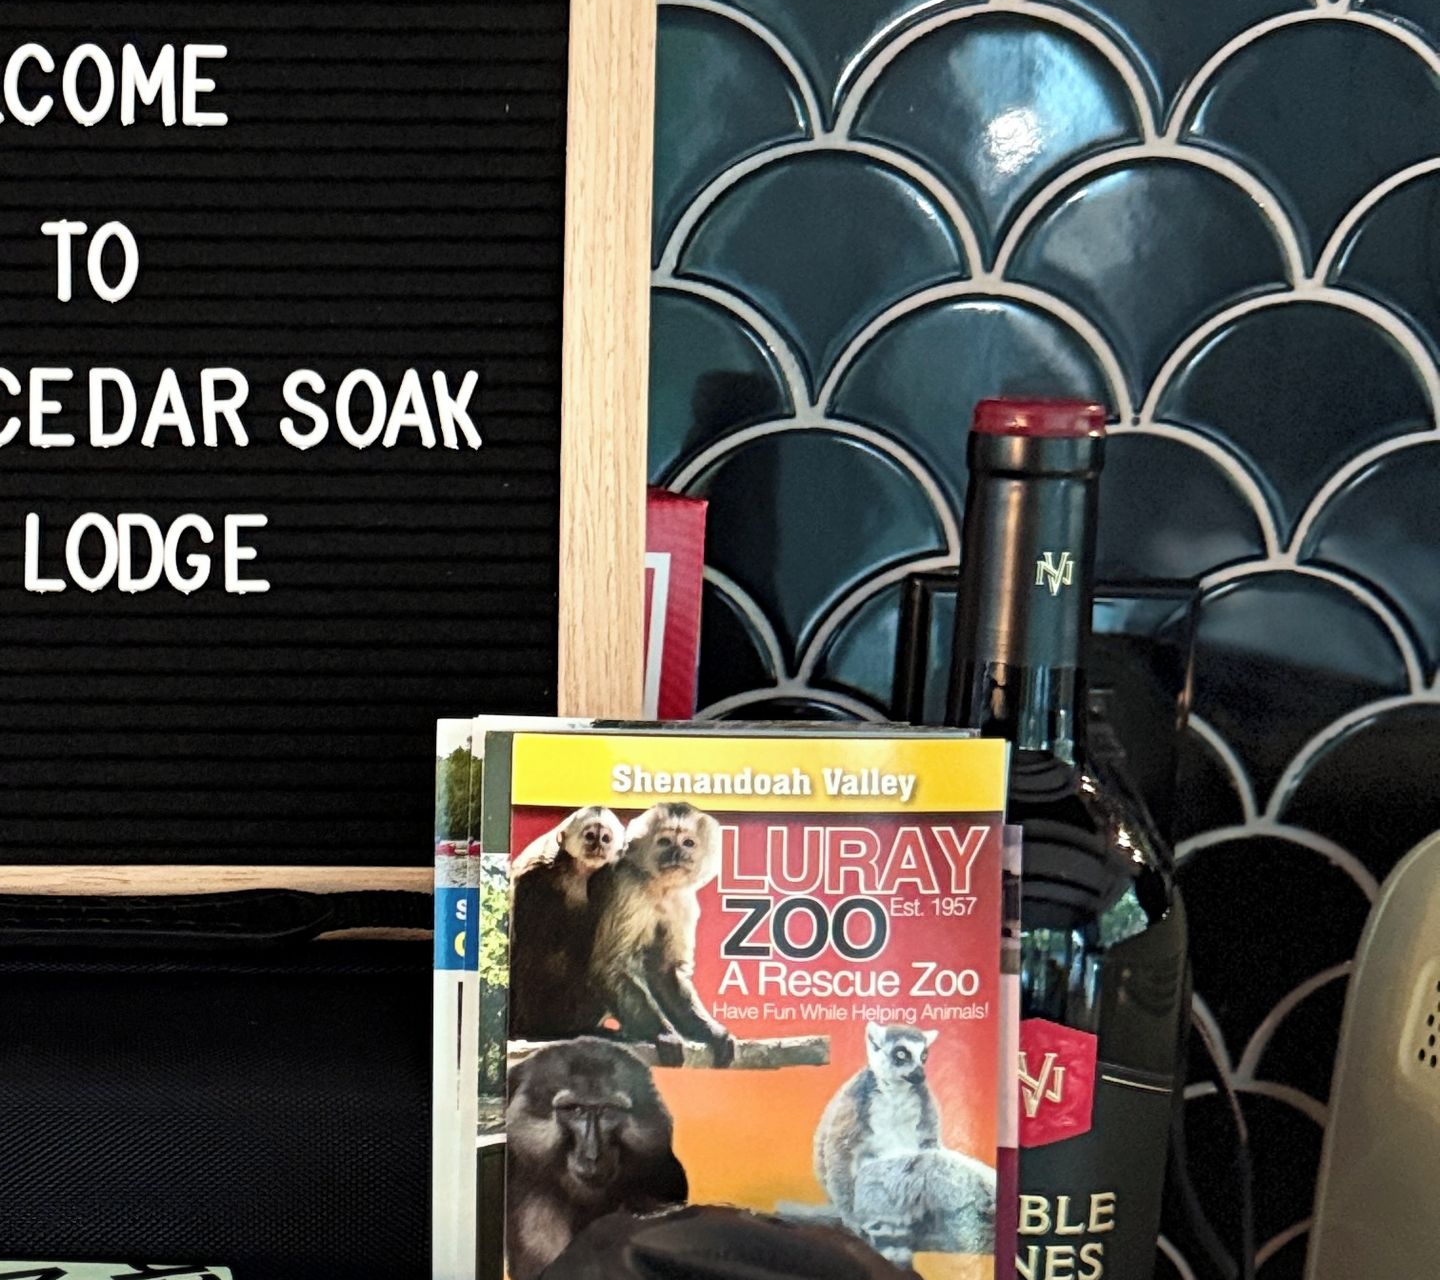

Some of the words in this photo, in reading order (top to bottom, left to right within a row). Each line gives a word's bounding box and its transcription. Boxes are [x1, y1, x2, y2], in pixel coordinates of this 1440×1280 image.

[40, 218, 140, 302] TO
[278, 369, 483, 450] SOAK
[23, 511, 271, 594] LODGE
[611, 764, 812, 796] Shenandoah
[822, 768, 917, 802] Valley
[717, 825, 991, 895] LURAY
[720, 895, 891, 962] ZOO
[890, 897, 924, 917] Est.
[930, 896, 978, 917] 1957
[718, 960, 749, 996] A
[758, 961, 900, 997] Rescue
[909, 961, 979, 997] Zoo
[712, 1002, 759, 1020] Have
[763, 1003, 796, 1021] Fun
[799, 1003, 847, 1021] While
[851, 1004, 917, 1024] Helping
[920, 1002, 990, 1021] Animals!
[1017, 1192, 1116, 1236] BLE
